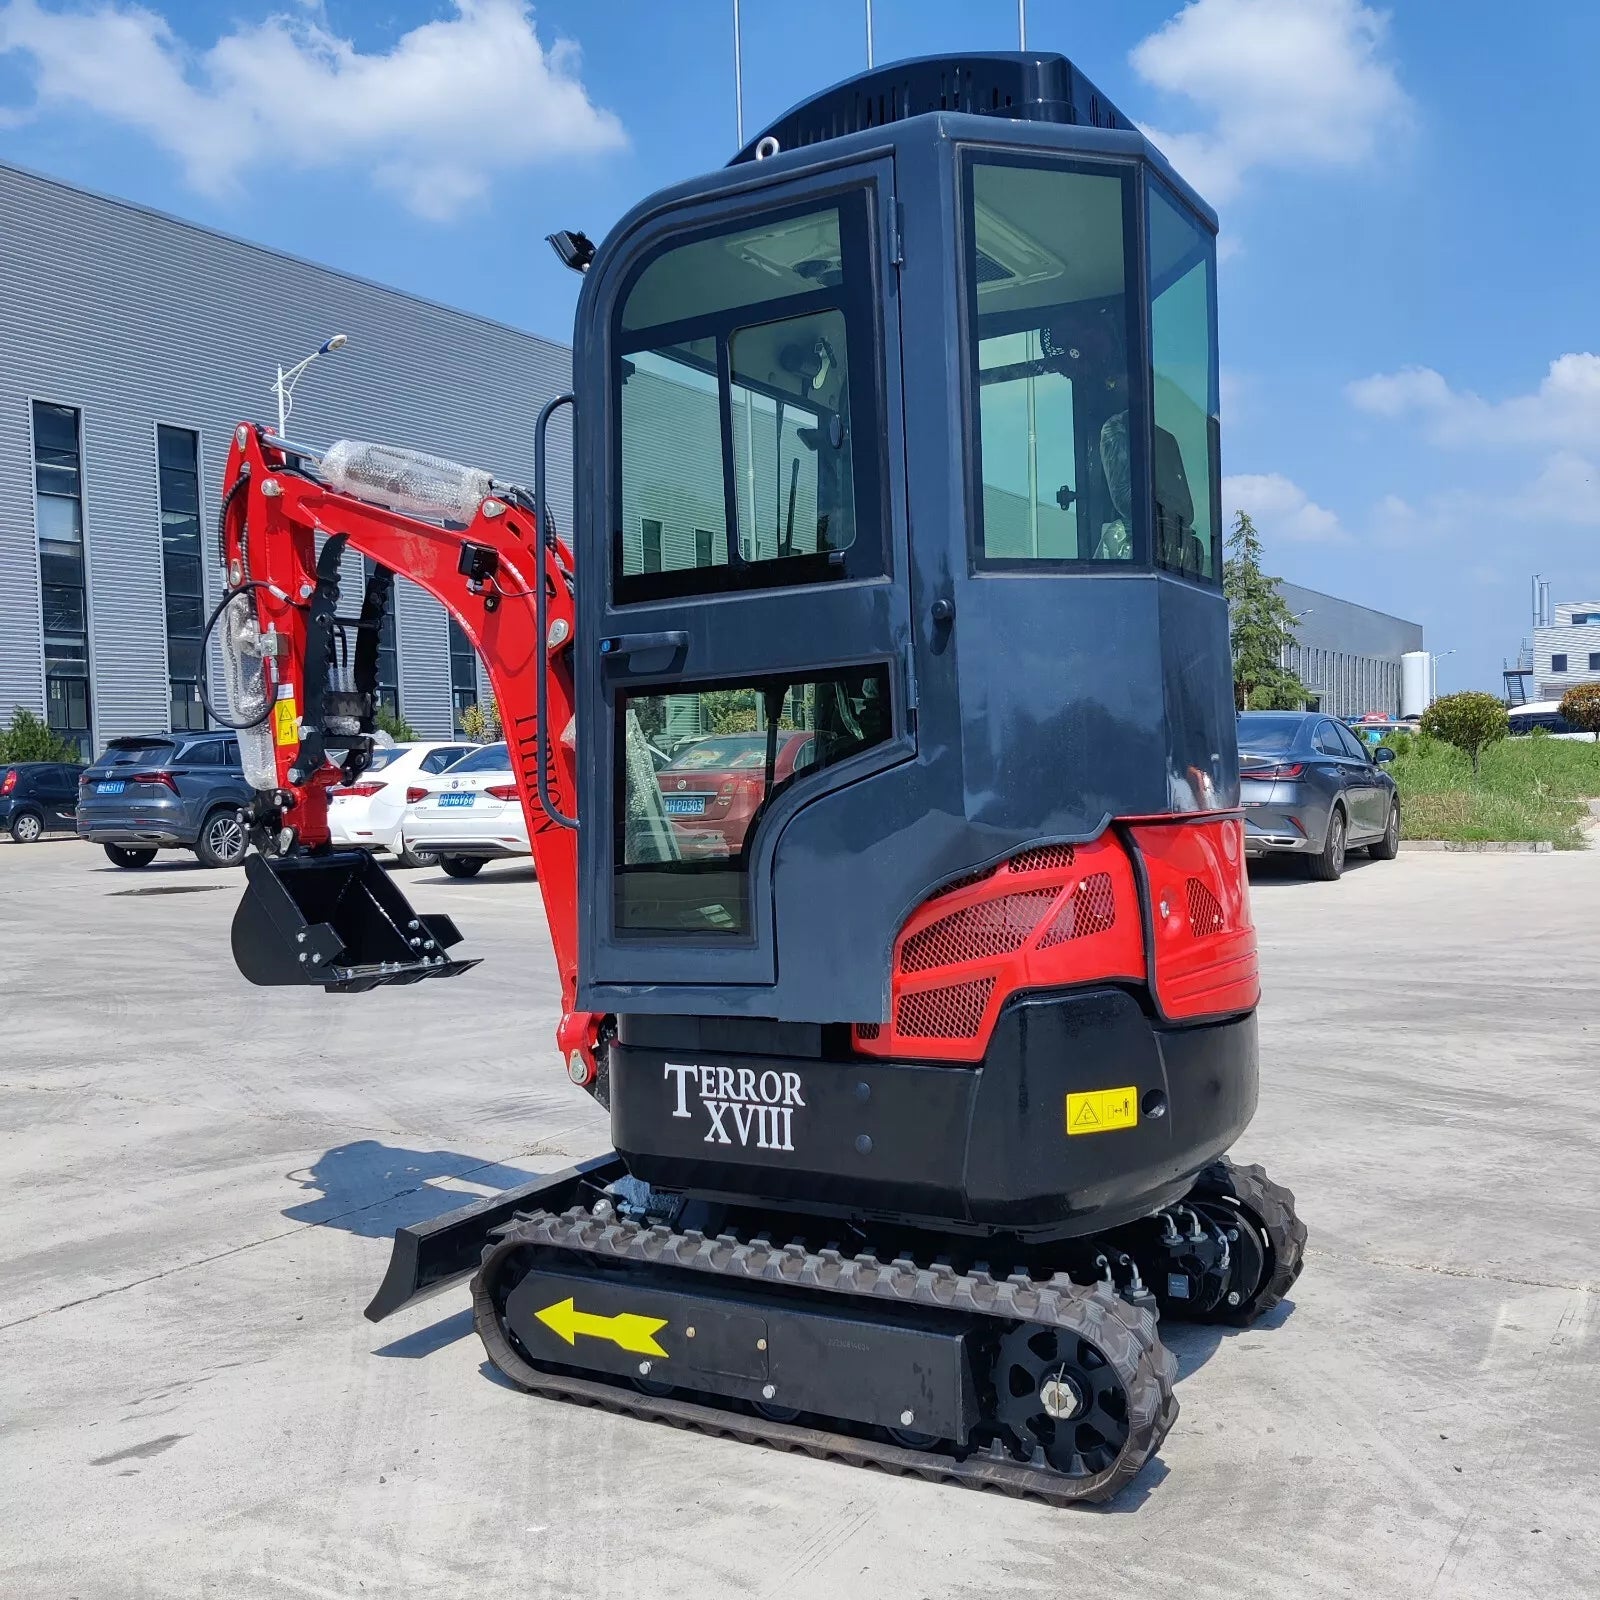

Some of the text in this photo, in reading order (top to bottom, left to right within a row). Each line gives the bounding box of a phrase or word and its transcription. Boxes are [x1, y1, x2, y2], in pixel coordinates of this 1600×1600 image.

[515, 714, 566, 834] YPHON
[664, 1062, 806, 1118] TERROR
[702, 1100, 795, 1151] XVIII
